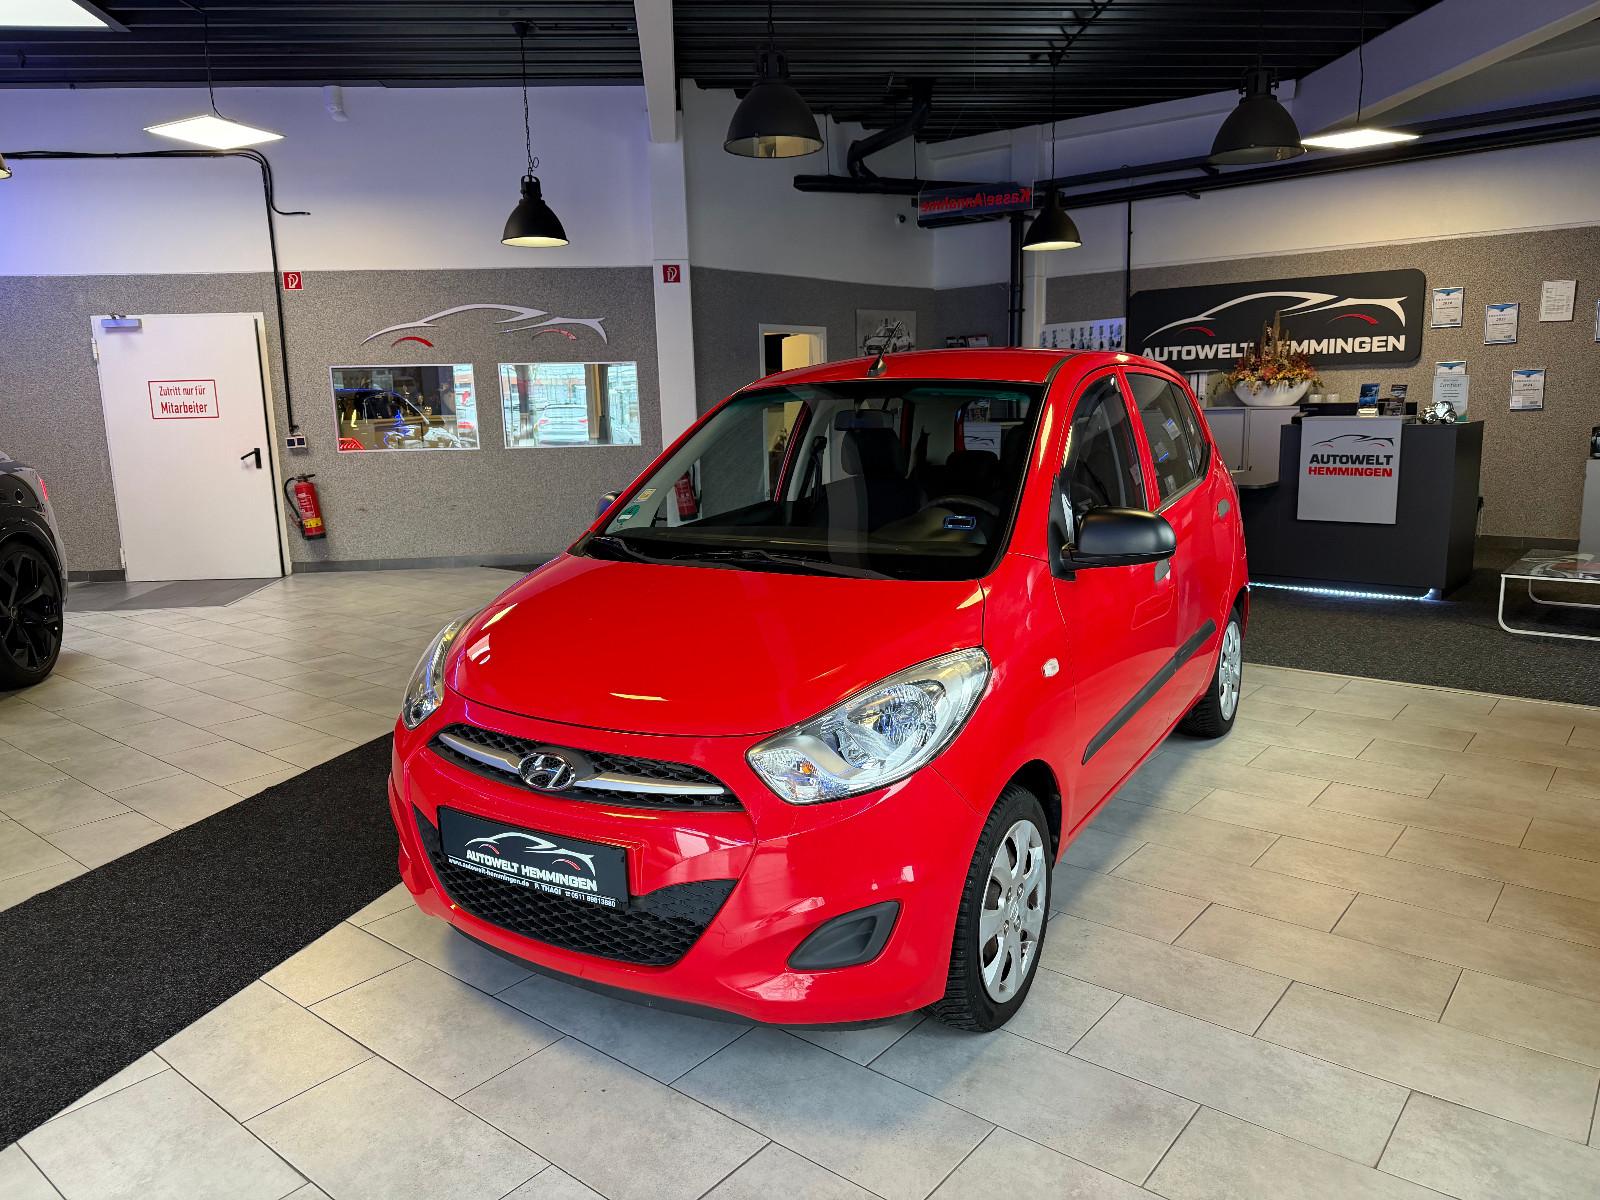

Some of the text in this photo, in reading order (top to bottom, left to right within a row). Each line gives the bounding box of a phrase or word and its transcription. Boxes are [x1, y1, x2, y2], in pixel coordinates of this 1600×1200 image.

[1141, 342, 1255, 362] AUTOWELT
[158, 384, 206, 397] Zutritt nur für
[160, 400, 208, 414] Mitarbeiter
[1309, 453, 1394, 466] AUTOWELT
[1308, 466, 1393, 478] HEMMINGEN
[466, 849, 598, 892] AUTOWELT HEMMINGEN
